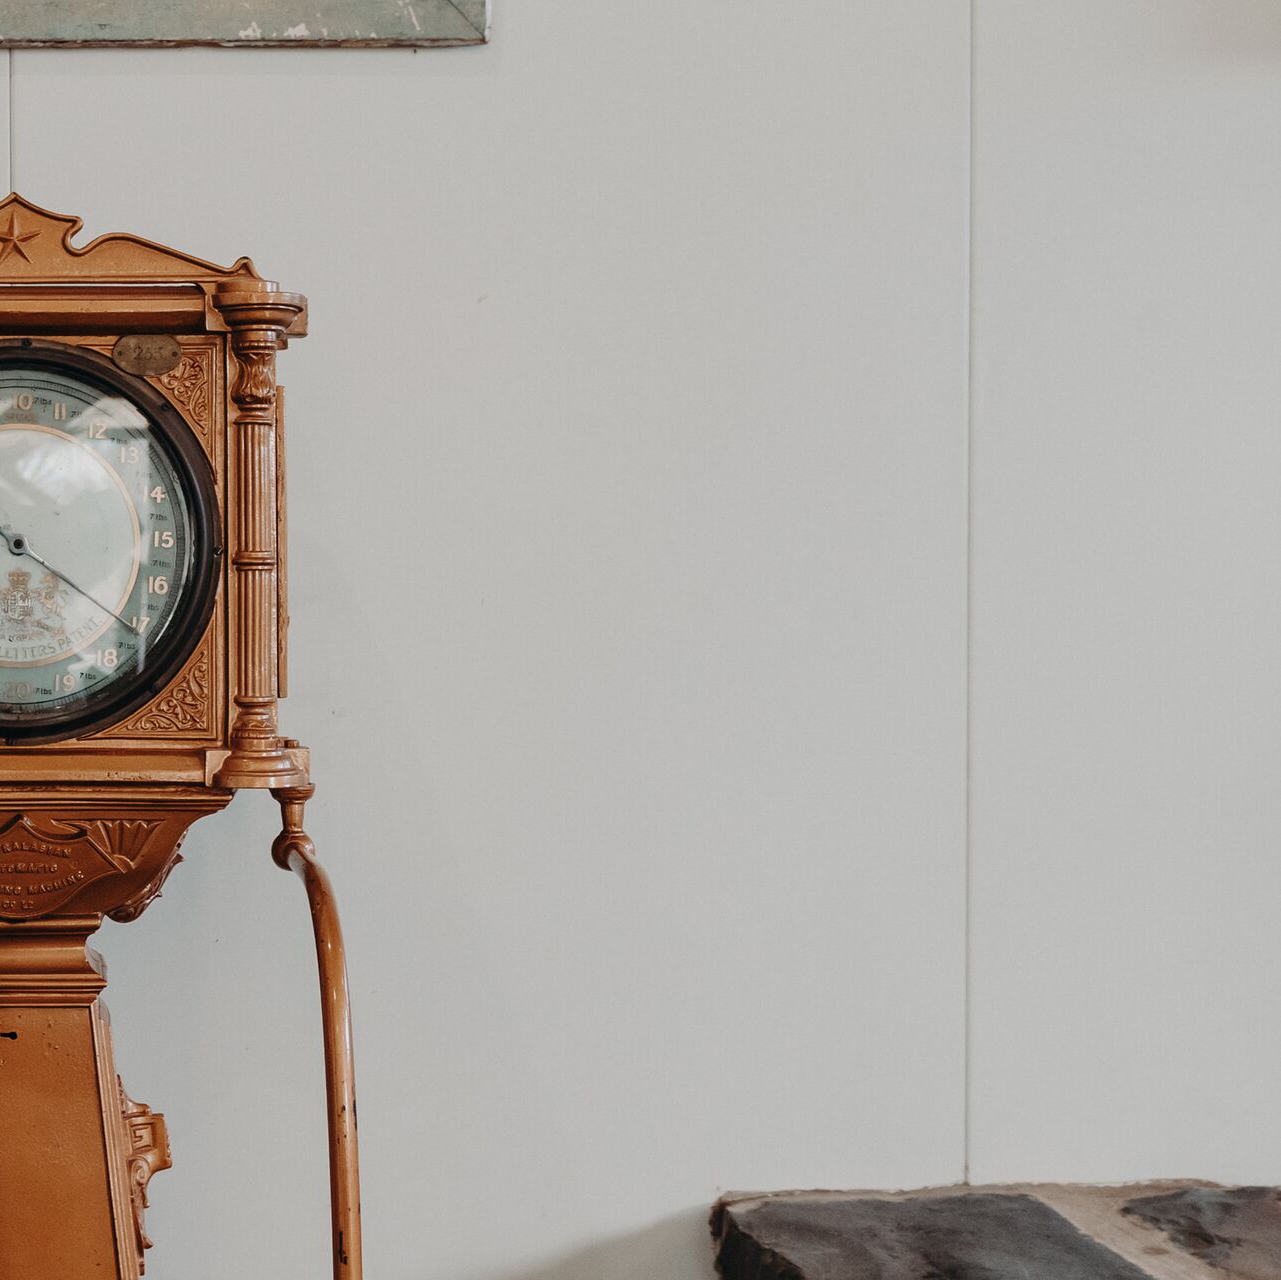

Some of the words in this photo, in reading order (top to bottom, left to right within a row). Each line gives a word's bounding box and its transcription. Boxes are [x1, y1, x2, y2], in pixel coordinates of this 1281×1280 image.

[13, 393, 34, 411] 10
[54, 401, 68, 420] 11
[87, 422, 108, 440] 12
[120, 446, 139, 465] 13
[142, 485, 166, 504] 14
[153, 530, 174, 549] 15
[147, 575, 169, 595] 16
[131, 616, 151, 634] 17
[96, 648, 118, 668] 18
[4, 680, 32, 700] 20
[54, 673, 77, 693] 19
[26, 869, 85, 896] MACHINE
